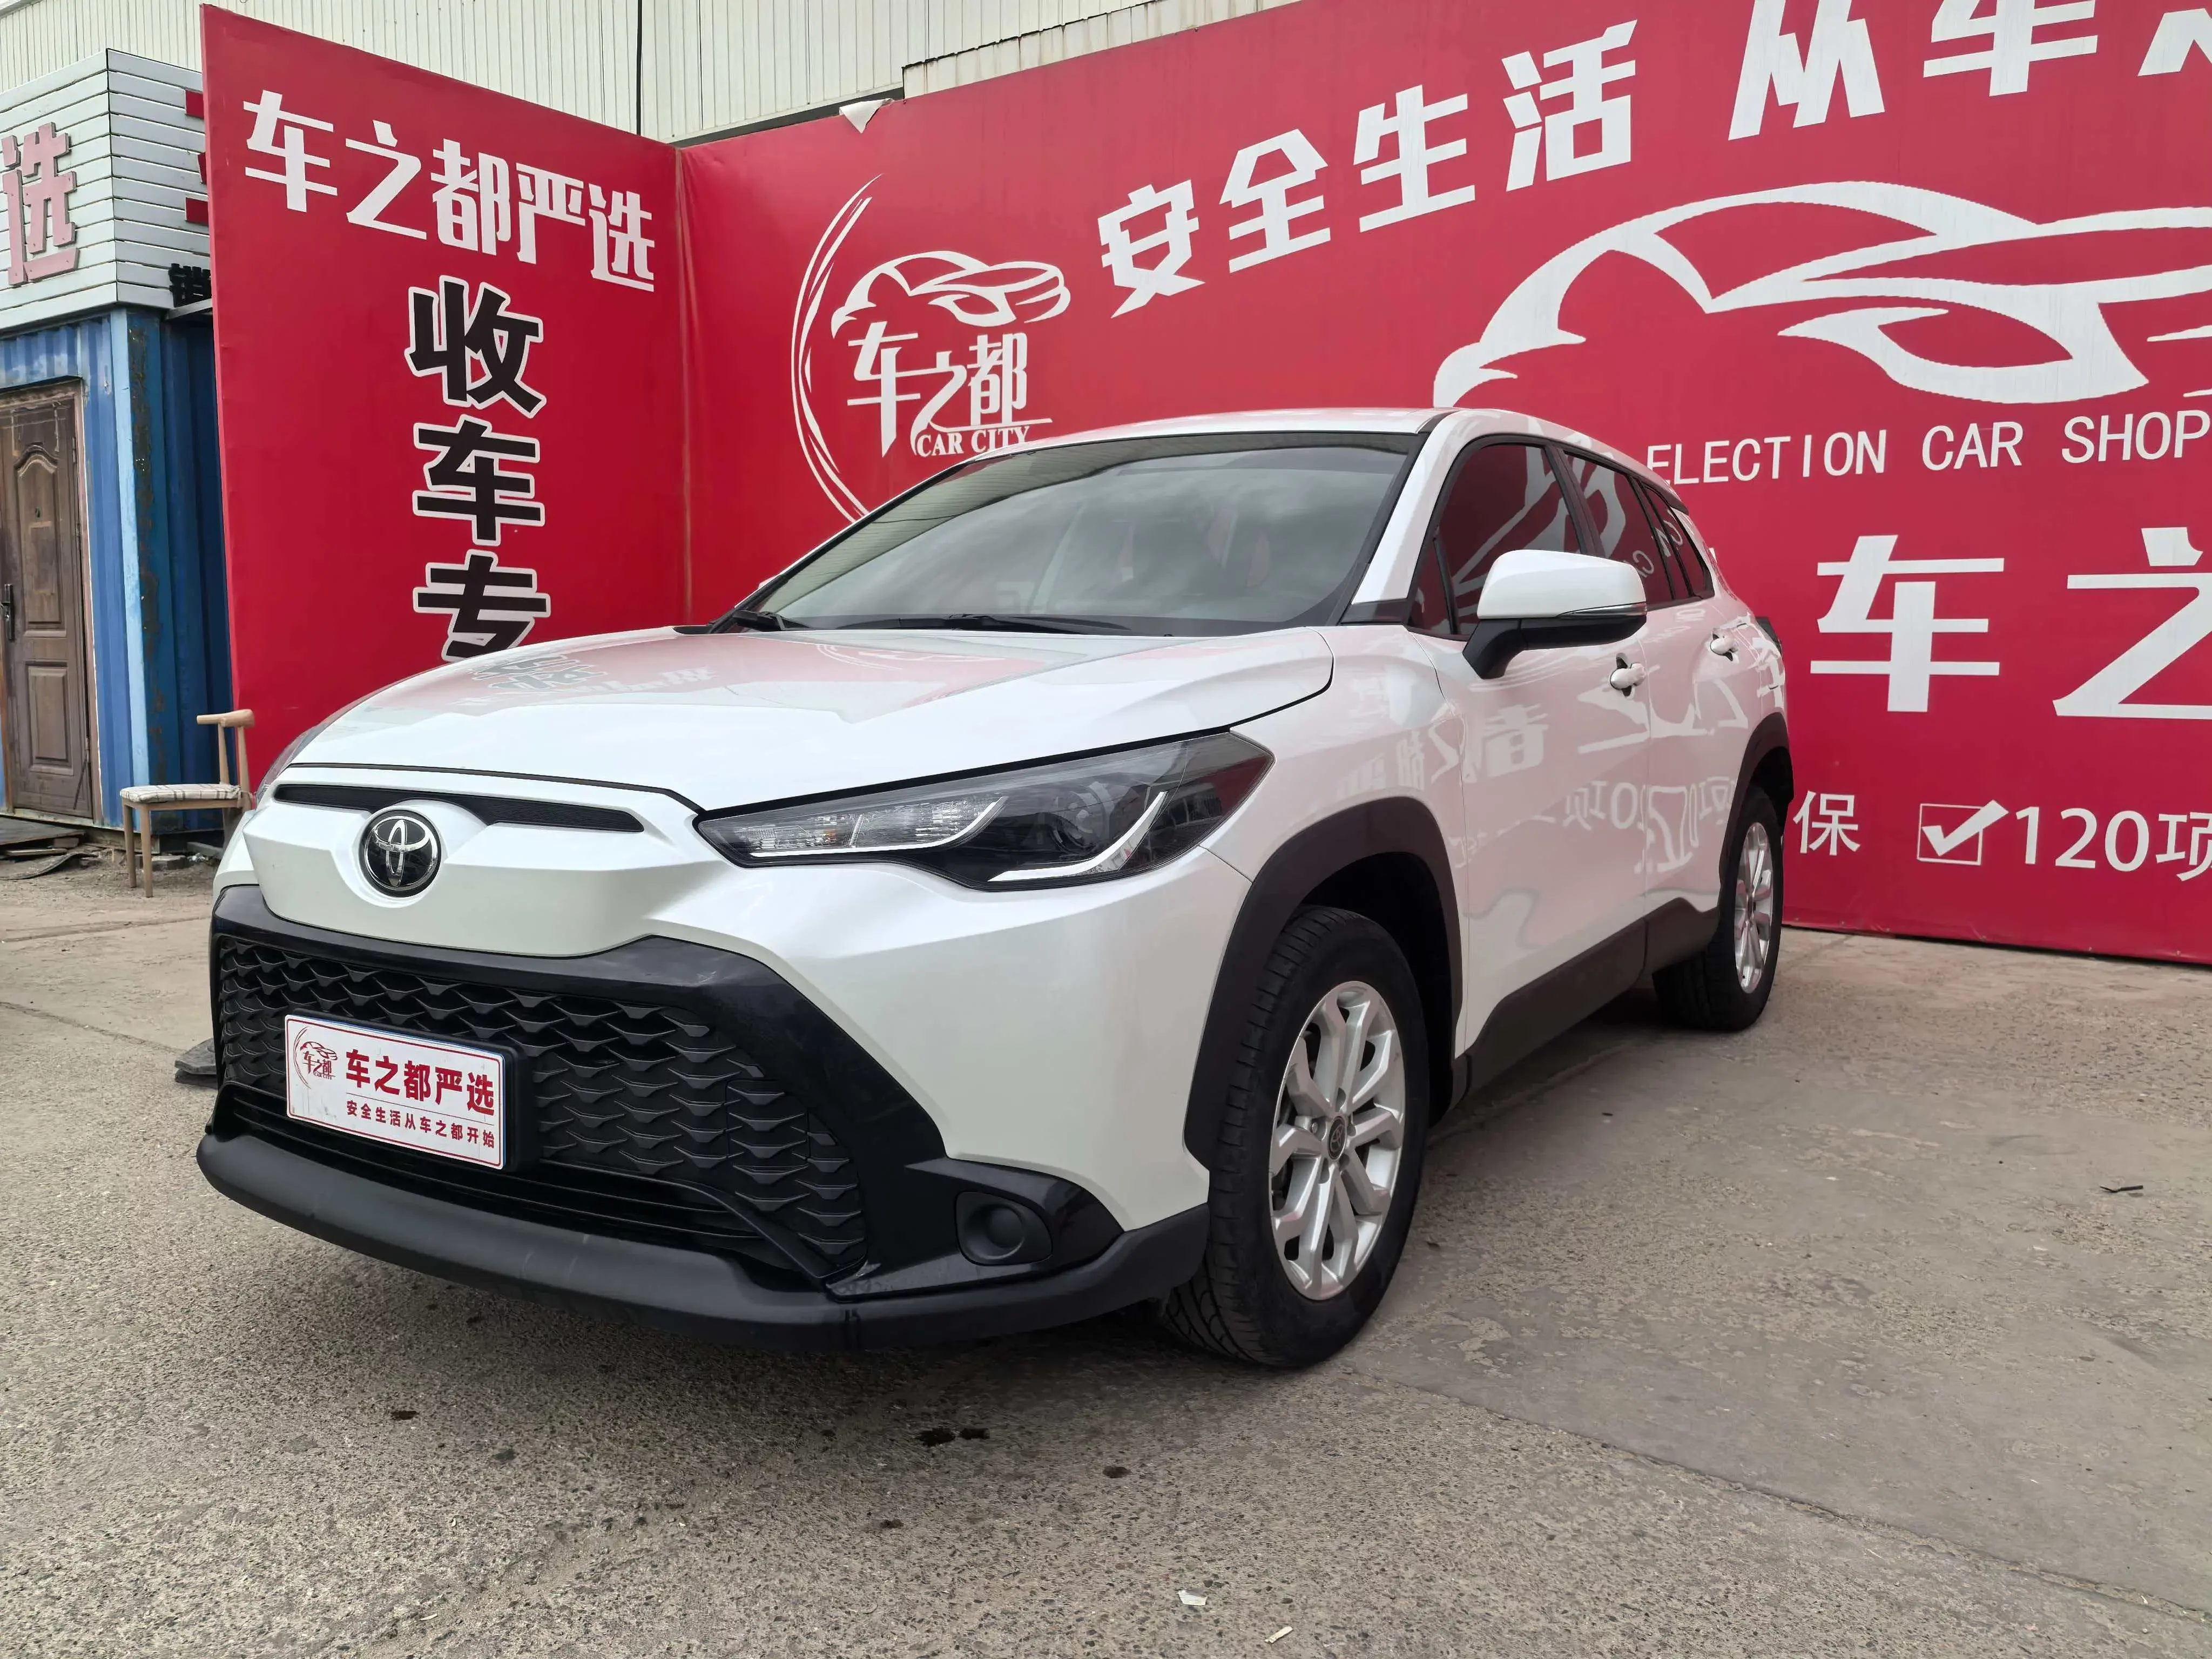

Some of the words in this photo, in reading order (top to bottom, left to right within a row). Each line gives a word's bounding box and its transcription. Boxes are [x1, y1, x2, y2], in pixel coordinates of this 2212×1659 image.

[2, 122, 79, 286] 选
[243, 90, 655, 292] 车之都严选
[1097, 19, 1637, 319] 安全生活
[847, 321, 1053, 457] 车之都
[917, 433, 964, 457] CAR
[971, 426, 1029, 453] CITY
[1922, 422, 2024, 471] CAR
[2061, 409, 2210, 463] SHOP
[1810, 527, 2212, 720] 车之
[1793, 790, 1861, 857] 保
[2015, 805, 2212, 881] 120项
[346, 1049, 495, 1116] 车之都严选
[346, 1100, 495, 1149] 安全生活从车之都开始
